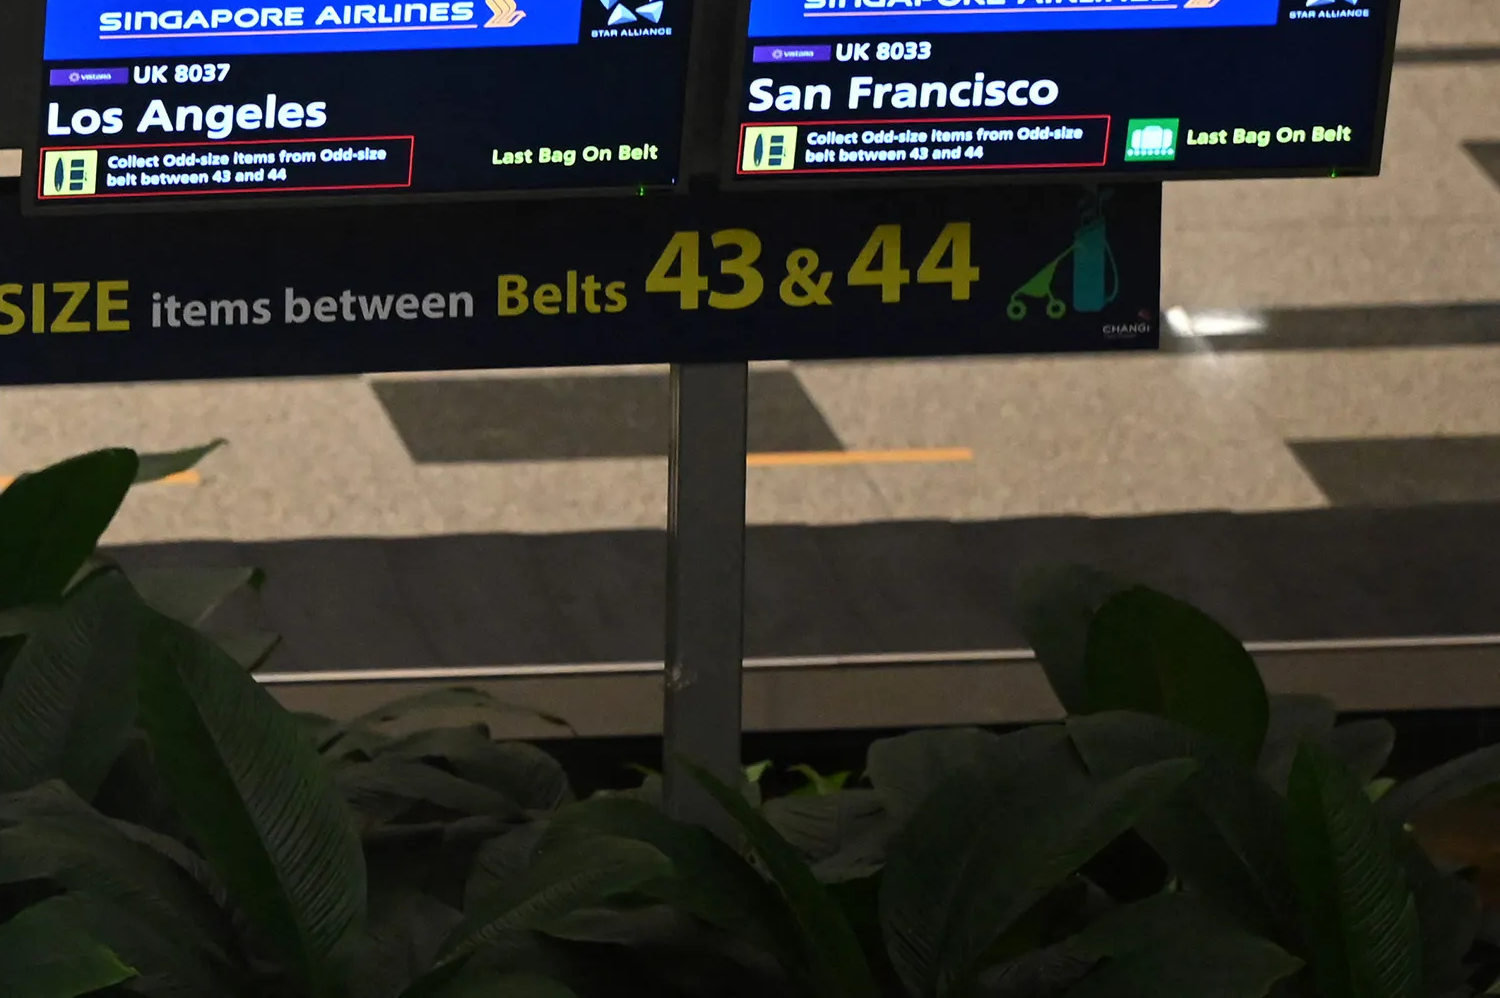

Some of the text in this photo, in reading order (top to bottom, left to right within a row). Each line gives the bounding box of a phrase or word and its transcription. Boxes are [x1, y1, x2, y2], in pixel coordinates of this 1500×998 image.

[99, 1, 474, 32] SINGAPORE AIRLINES
[1289, 8, 1370, 20] STAR ALLIANCE
[590, 27, 672, 38] STAR ALLIANCE
[835, 40, 932, 62] UK 8033
[133, 62, 231, 84] UK 8037
[748, 71, 1059, 112] San Francisco
[47, 93, 327, 140] Los Angeles
[806, 130, 859, 146] Collect
[861, 129, 928, 145] Odd-size
[975, 127, 1014, 142] from
[1016, 125, 1084, 141] Odd-size
[1186, 124, 1352, 148] Last Bag On Belt
[107, 154, 160, 170] Collect
[162, 152, 230, 168] Odd-size
[278, 149, 317, 164] from
[319, 146, 387, 162] Odd-size
[491, 143, 659, 167] Last Bag On Belt
[804, 145, 984, 163] belt between 43 and 44
[106, 167, 287, 187] belt between 43 and 44
[152, 291, 272, 328] items
[284, 287, 474, 324] between
[497, 269, 628, 317] Belts
[645, 228, 764, 310] 43
[778, 248, 834, 307] &
[847, 222, 980, 303] 44
